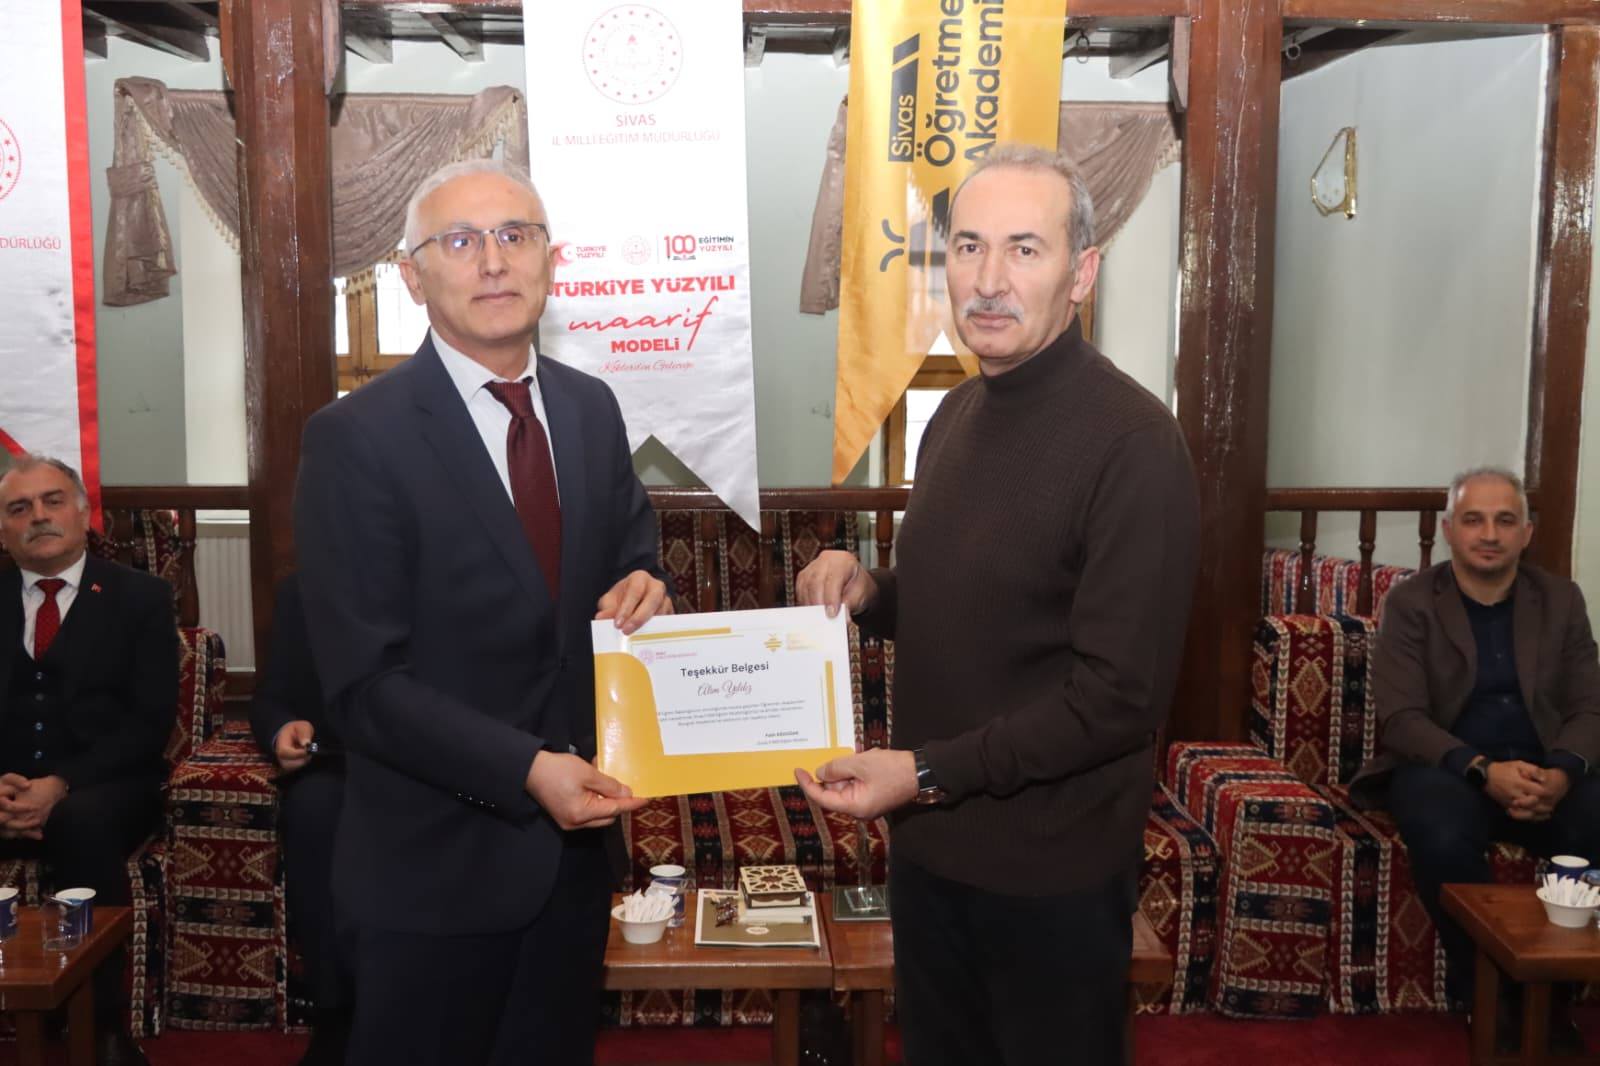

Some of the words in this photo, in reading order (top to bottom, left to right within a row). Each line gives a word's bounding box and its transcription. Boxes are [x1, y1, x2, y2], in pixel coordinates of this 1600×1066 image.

[891, 94, 914, 157] Sivas
[664, 235, 696, 259] 100
[698, 235, 734, 244] EĞİTİMİN
[700, 244, 733, 252] YÜZYILI
[554, 278, 645, 298] TÜRKİYE
[651, 275, 736, 293] YÜZYILI
[568, 295, 719, 352] maarif
[611, 337, 680, 353] MODELİ
[680, 664, 728, 678] Teşekkür
[731, 661, 769, 674] Belgesi
